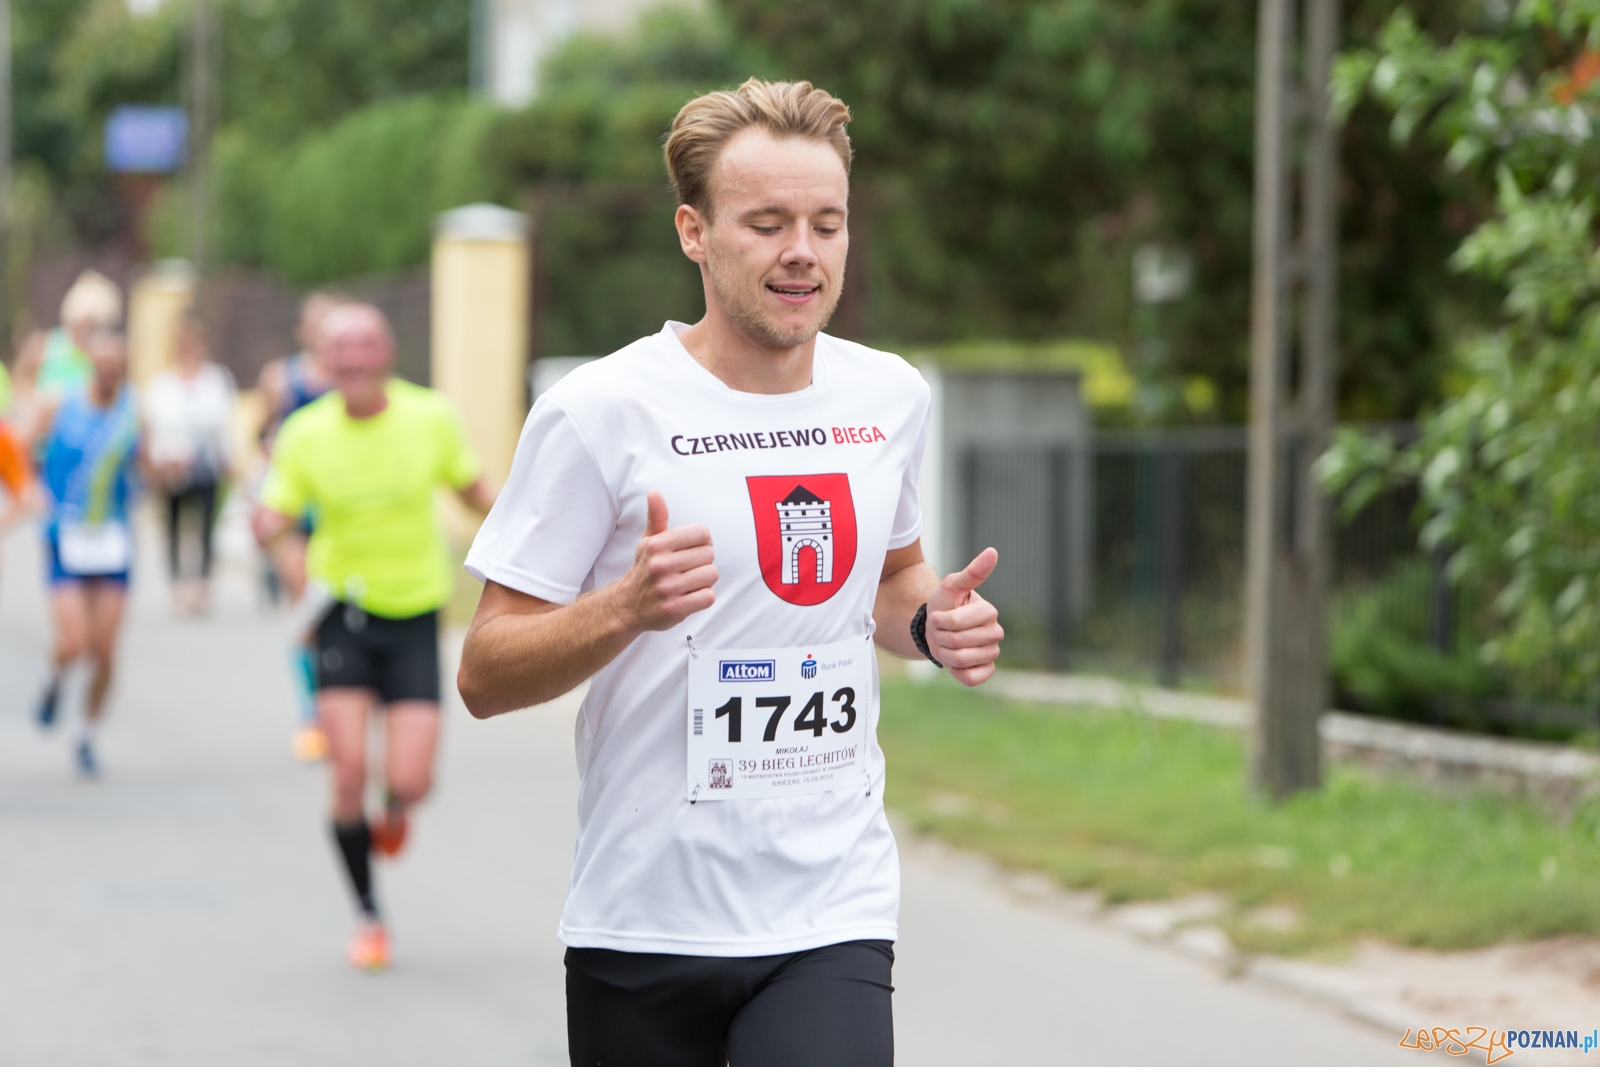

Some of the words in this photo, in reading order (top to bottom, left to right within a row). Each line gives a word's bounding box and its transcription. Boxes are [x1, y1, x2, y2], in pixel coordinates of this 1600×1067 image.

[671, 427, 827, 456] CZERNIEJEWO
[831, 426, 886, 444] BIEGA
[821, 662, 837, 671] Bank
[838, 657, 853, 668] Polski
[715, 686, 857, 743] 1743
[738, 759, 757, 773] 39
[762, 757, 795, 771] BIEG
[799, 744, 858, 768] LECHITÓW
[775, 745, 809, 755] MIKOŁAJ
